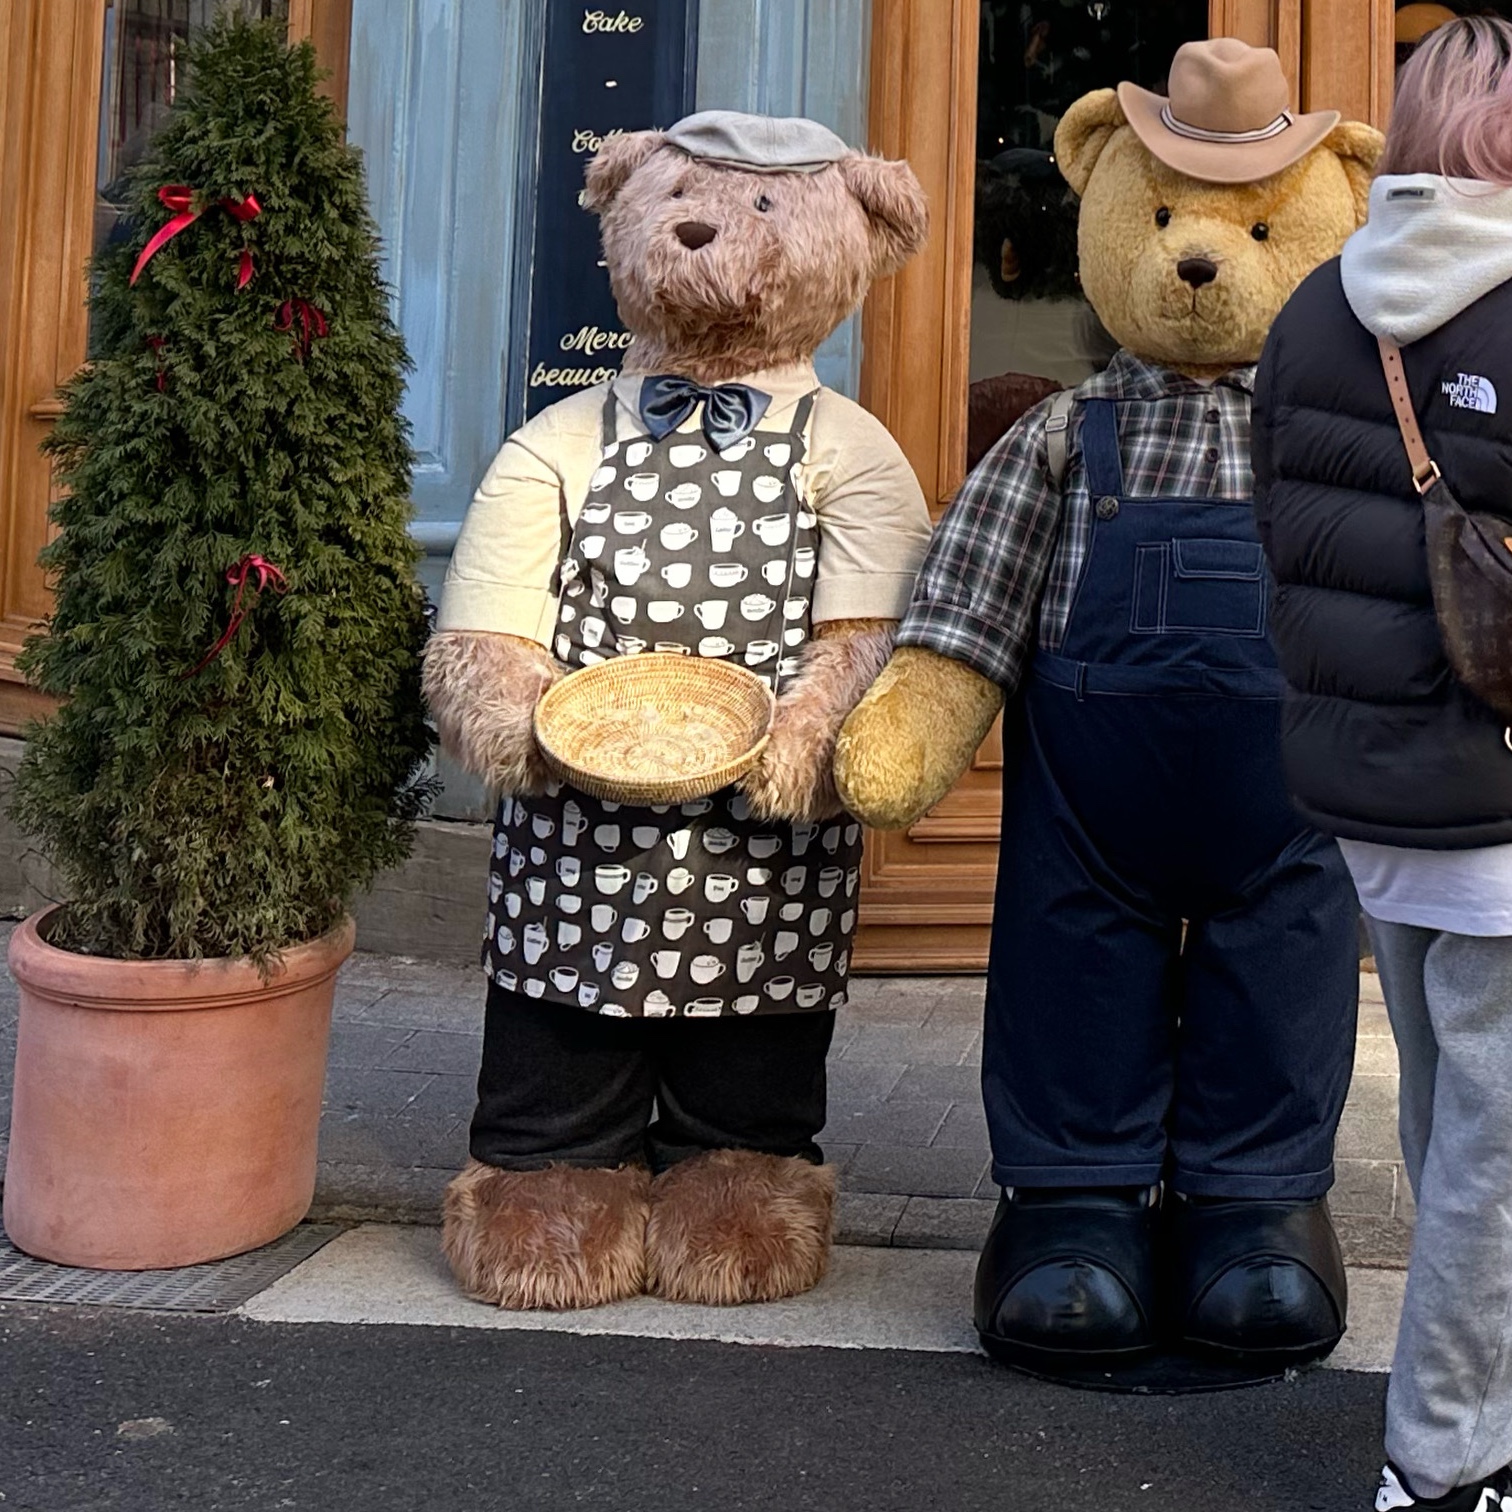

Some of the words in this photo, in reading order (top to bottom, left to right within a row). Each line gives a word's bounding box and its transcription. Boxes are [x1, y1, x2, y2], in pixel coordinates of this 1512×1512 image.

[582, 9, 644, 34] Cake
[1457, 373, 1480, 388] THE
[1441, 382, 1479, 399] NORTH
[1449, 394, 1478, 409] FACE
